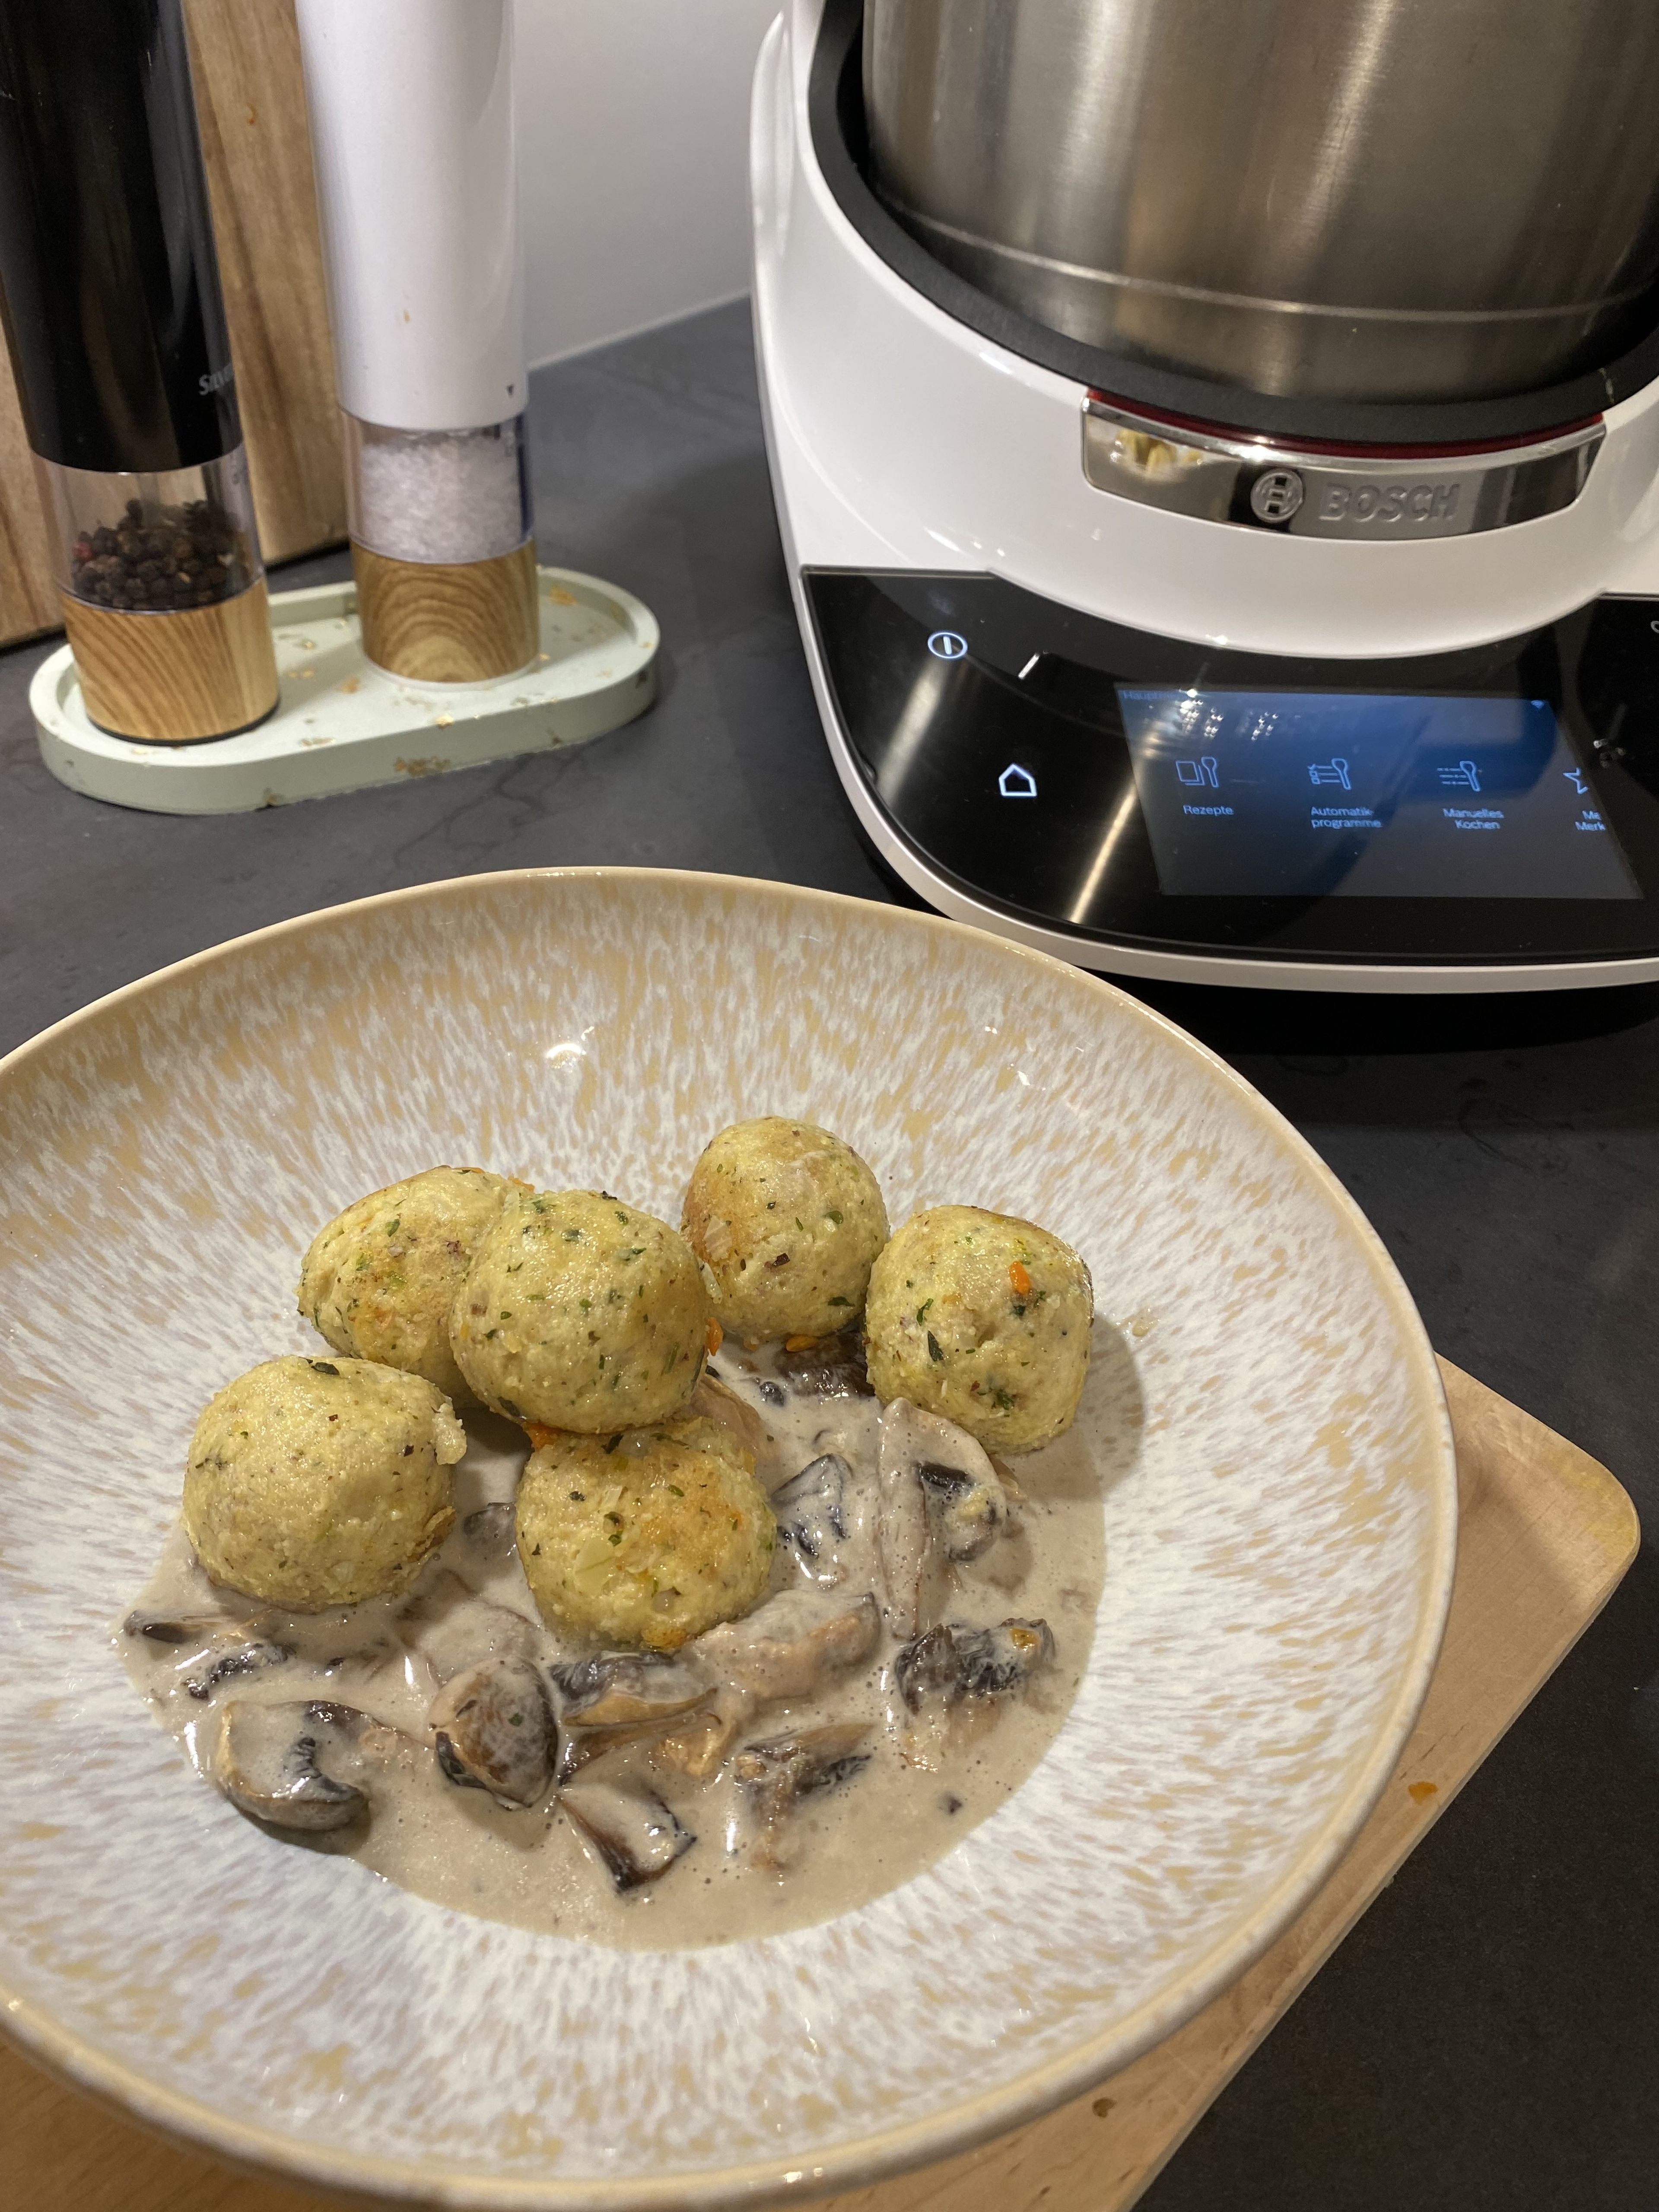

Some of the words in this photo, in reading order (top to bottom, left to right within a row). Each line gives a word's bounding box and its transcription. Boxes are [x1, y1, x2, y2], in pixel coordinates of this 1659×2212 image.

[1319, 483, 1460, 521] BOSCH
[1183, 804, 1234, 816] Rezepte
[1443, 808, 1504, 819] Manuelles
[1311, 820, 1382, 829] programme
[1455, 820, 1501, 830] Kochen
